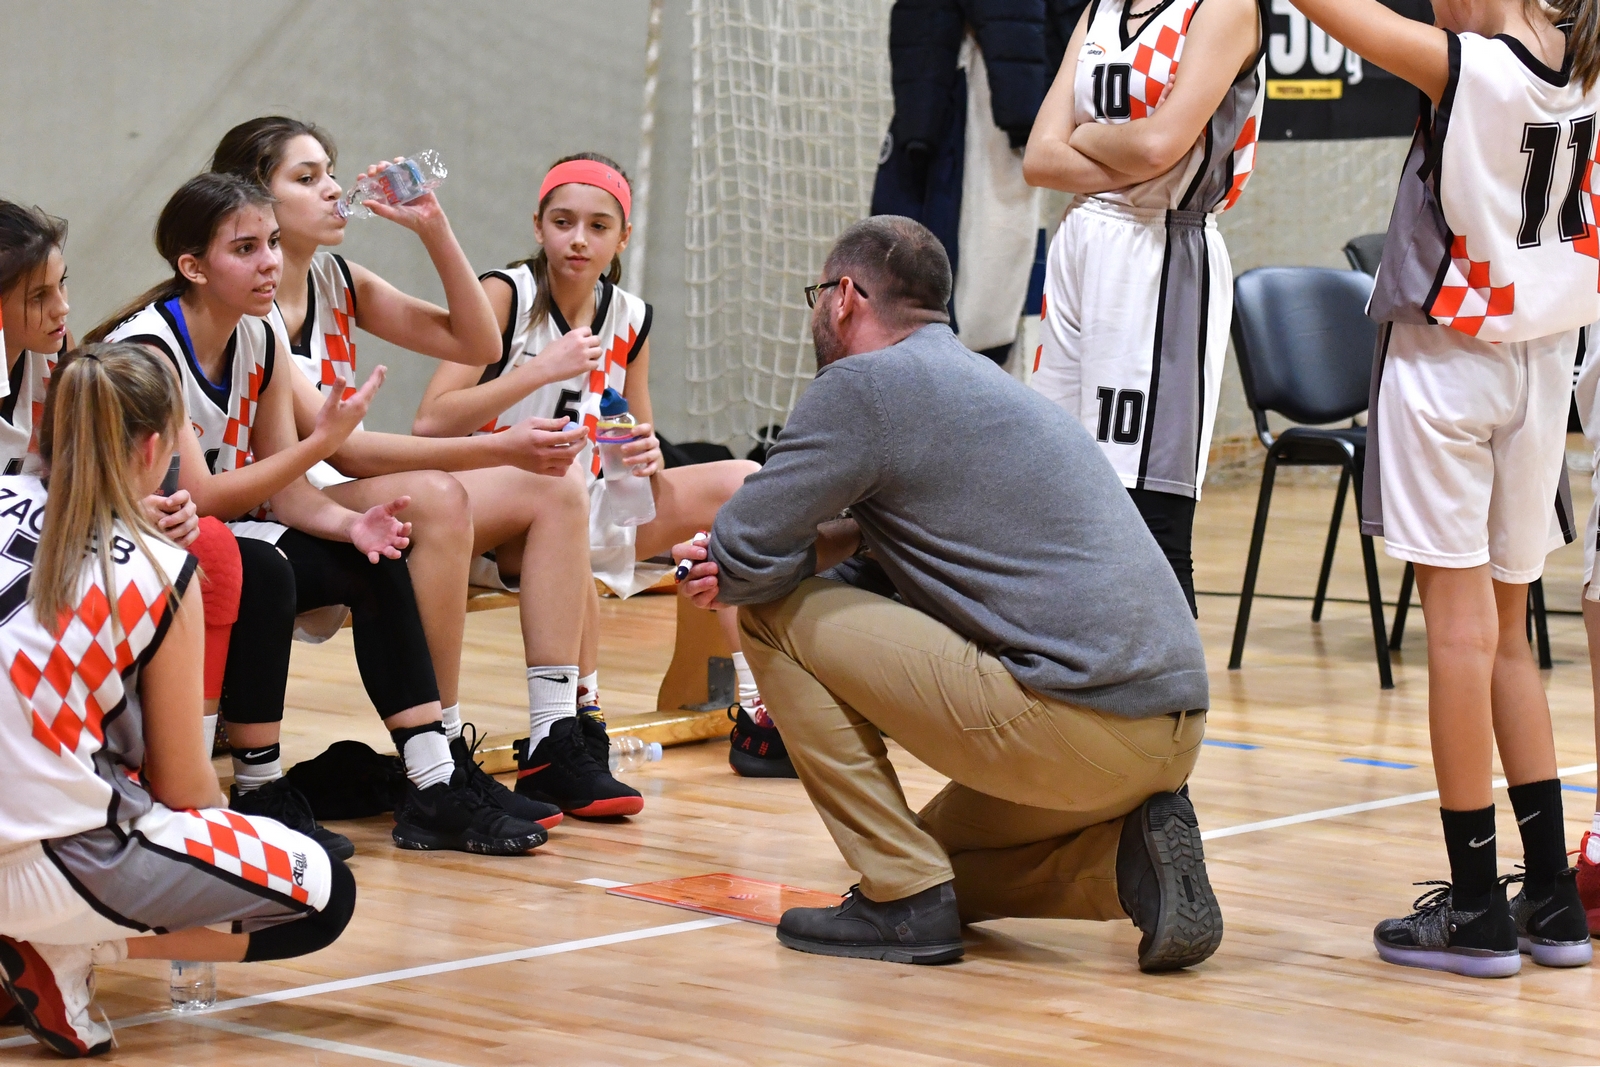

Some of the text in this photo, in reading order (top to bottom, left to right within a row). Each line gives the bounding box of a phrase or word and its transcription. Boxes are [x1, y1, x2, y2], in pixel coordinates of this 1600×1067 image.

[1091, 62, 1132, 119] 10
[1517, 112, 1596, 249] 11
[553, 388, 582, 429] 5
[1096, 385, 1146, 445] 10
